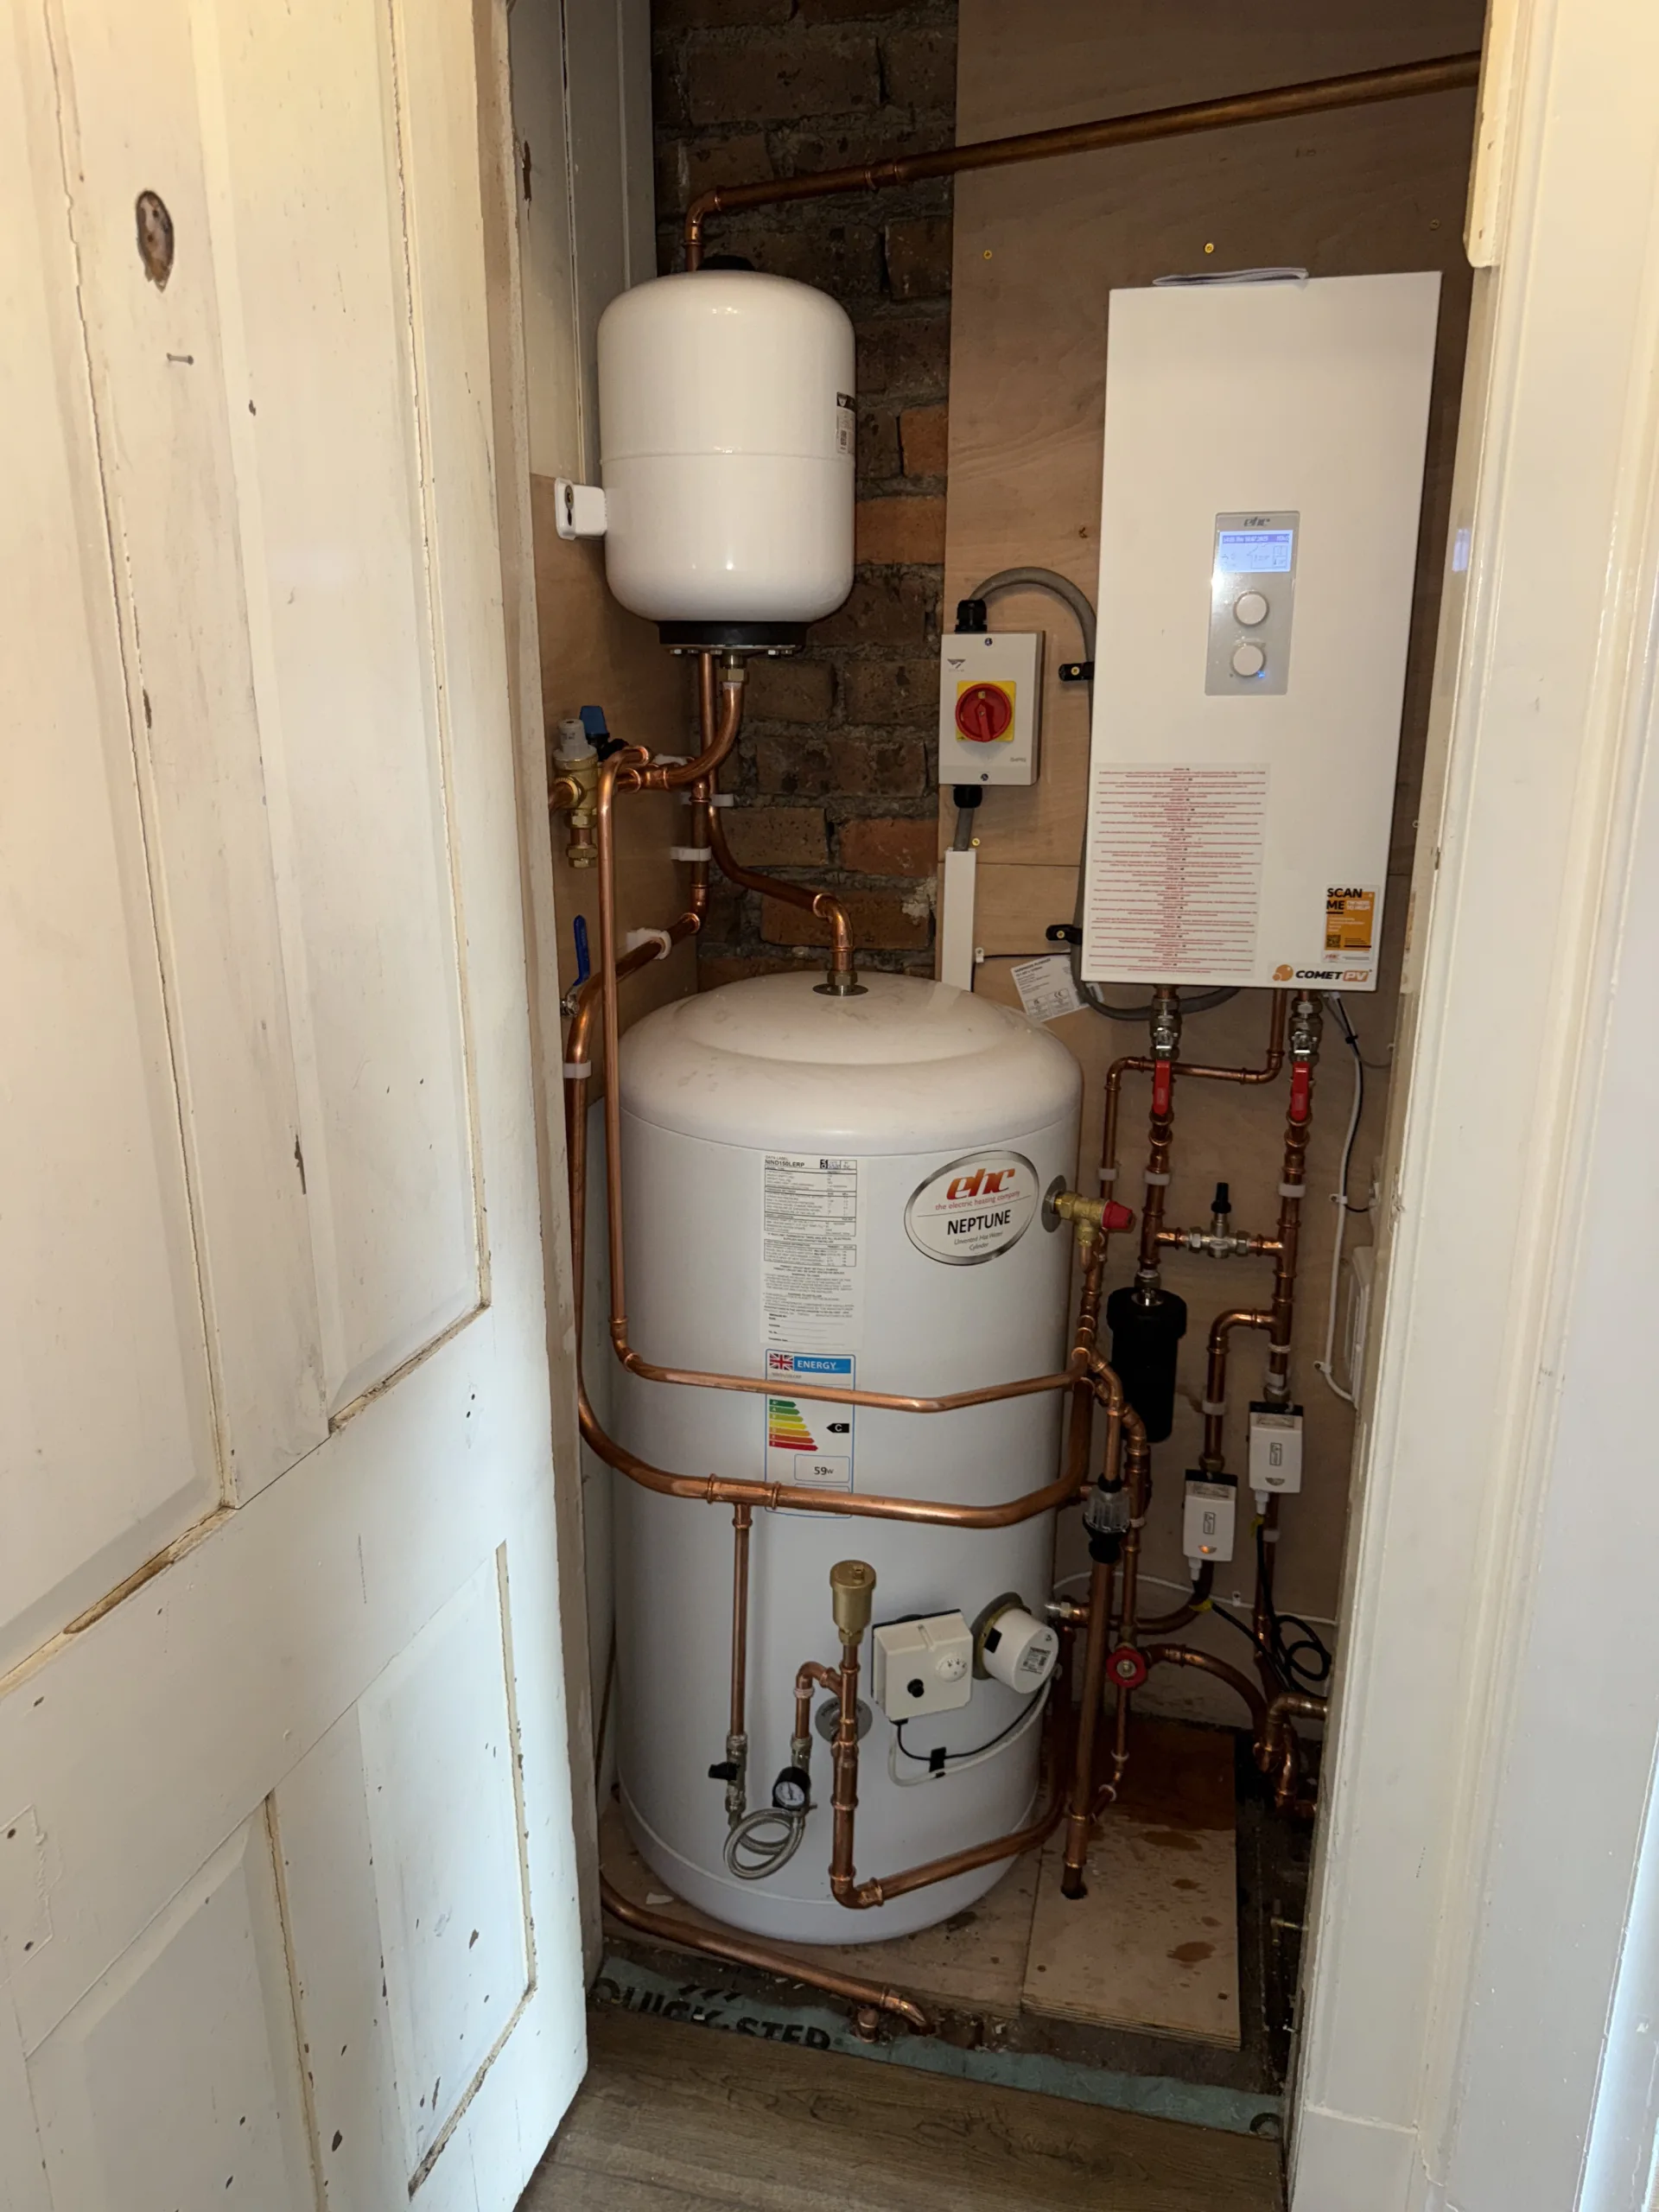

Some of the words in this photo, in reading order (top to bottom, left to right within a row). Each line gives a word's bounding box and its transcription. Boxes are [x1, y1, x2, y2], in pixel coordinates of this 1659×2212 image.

[1326, 887, 1363, 898] SCAN
[1326, 900, 1344, 910] ME
[1295, 969, 1344, 980] COMET
[1344, 971, 1368, 981] PV
[946, 1168, 1016, 1200] ehc
[948, 1199, 974, 1210] electric
[974, 1196, 996, 1206] heating
[996, 1190, 1020, 1202] company
[947, 1210, 1011, 1236] NEPTUNE
[797, 1360, 836, 1370] ENERGY
[834, 1423, 842, 1433] C
